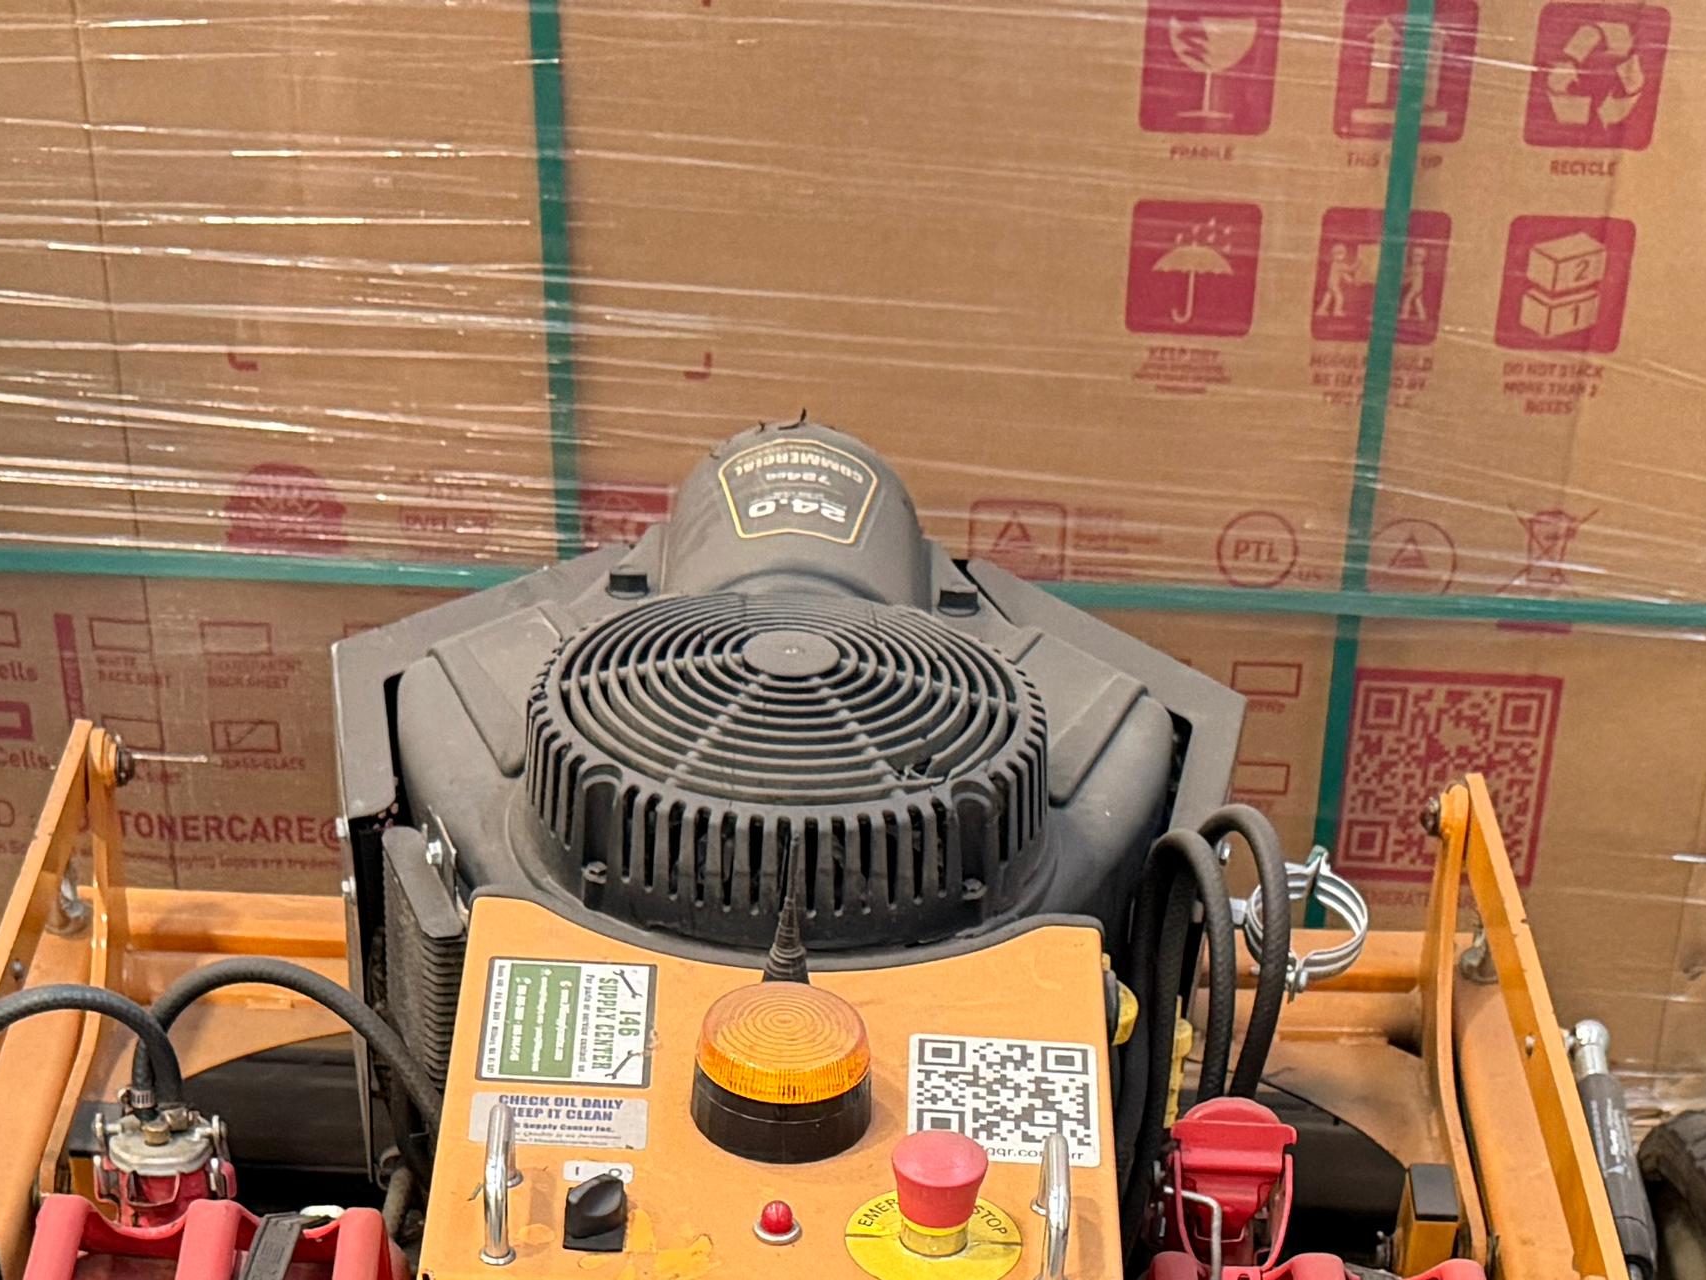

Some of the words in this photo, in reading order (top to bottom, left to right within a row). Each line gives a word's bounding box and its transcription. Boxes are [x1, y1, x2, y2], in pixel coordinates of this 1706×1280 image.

[1549, 159, 1617, 177] RECYCLE
[735, 451, 864, 484] COMMERCIAL
[748, 499, 847, 523] 24.0
[596, 977, 619, 1020] SUPPLY
[591, 1023, 615, 1070] CENTER
[498, 1094, 551, 1107] CHECK
[552, 1096, 578, 1108] OIL
[580, 1098, 624, 1110] DAILY
[547, 1108, 563, 1120] IT
[565, 1109, 614, 1121] CLEAN
[523, 1122, 557, 1131] Supply
[559, 1123, 593, 1132] Center
[973, 1205, 1009, 1236] STOP
